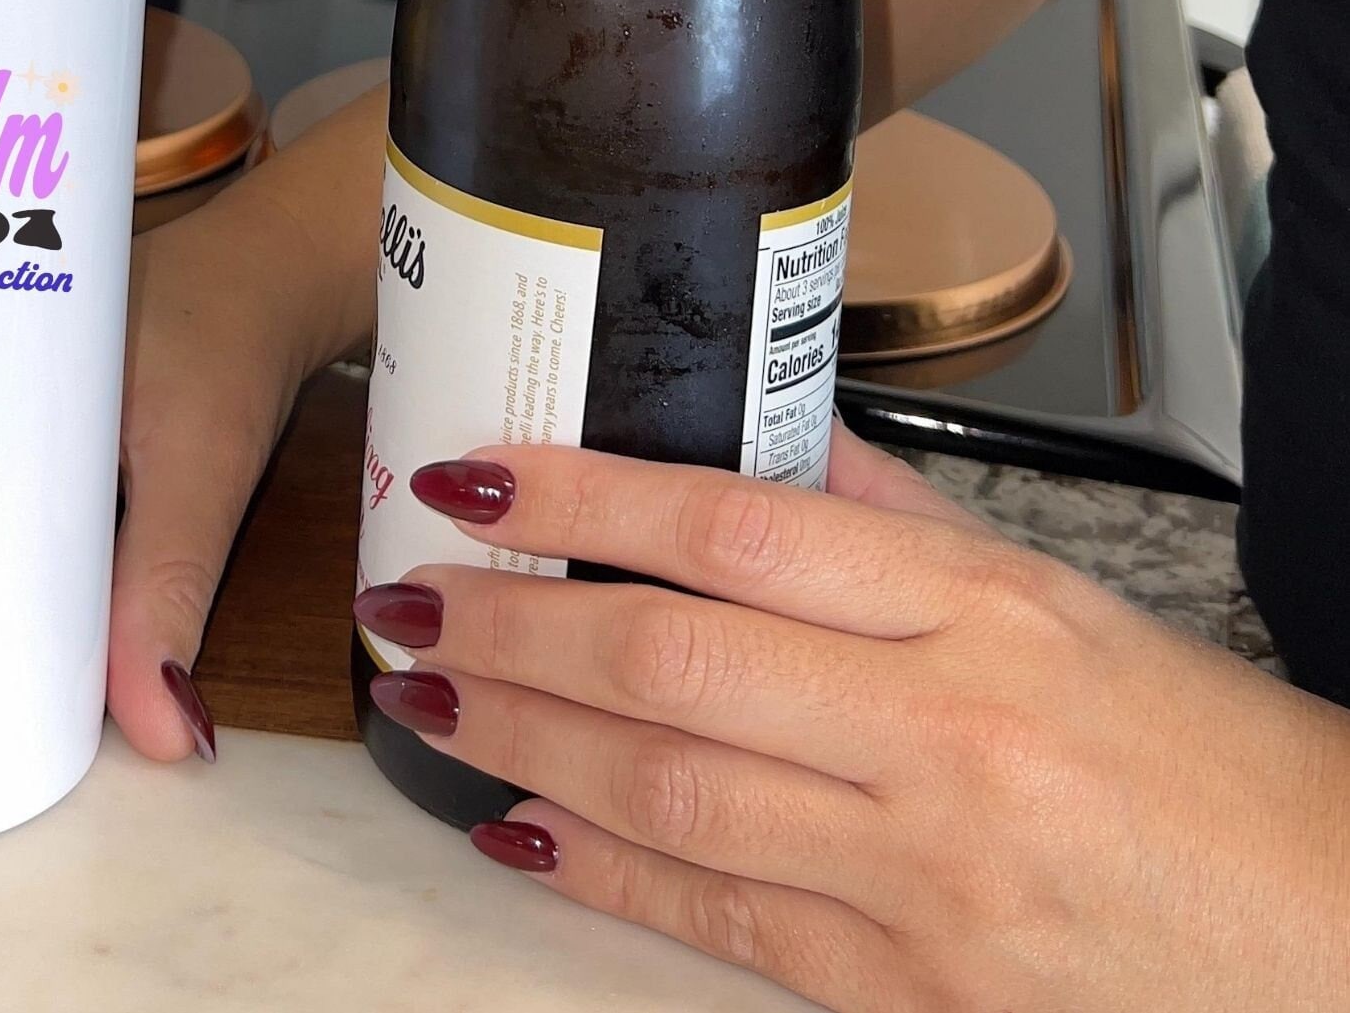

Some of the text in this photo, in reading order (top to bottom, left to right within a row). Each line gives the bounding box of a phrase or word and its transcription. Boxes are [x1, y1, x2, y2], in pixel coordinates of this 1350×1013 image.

[776, 238, 839, 282] Nutrition
[515, 272, 528, 299] and
[536, 276, 548, 290] to
[774, 283, 801, 304] About
[802, 279, 808, 293] 3
[511, 300, 527, 331] 1868,
[531, 290, 547, 328] Here's
[550, 289, 567, 334] Cheers!
[772, 294, 822, 323] Serving size
[508, 334, 523, 365] since
[531, 329, 546, 354] way.
[548, 338, 562, 370] come.
[769, 341, 791, 354] Amount
[525, 355, 540, 376] the
[767, 344, 824, 384] Calories
[504, 366, 519, 417] products
[546, 372, 559, 386] to
[521, 377, 541, 420] leading
[546, 386, 559, 418] years
[763, 411, 783, 428] Total
[785, 406, 797, 421] Fat
[768, 425, 801, 447] Saturated
[801, 418, 810, 433] Fat
[768, 448, 789, 466] Trans
[789, 442, 801, 456] Fat
